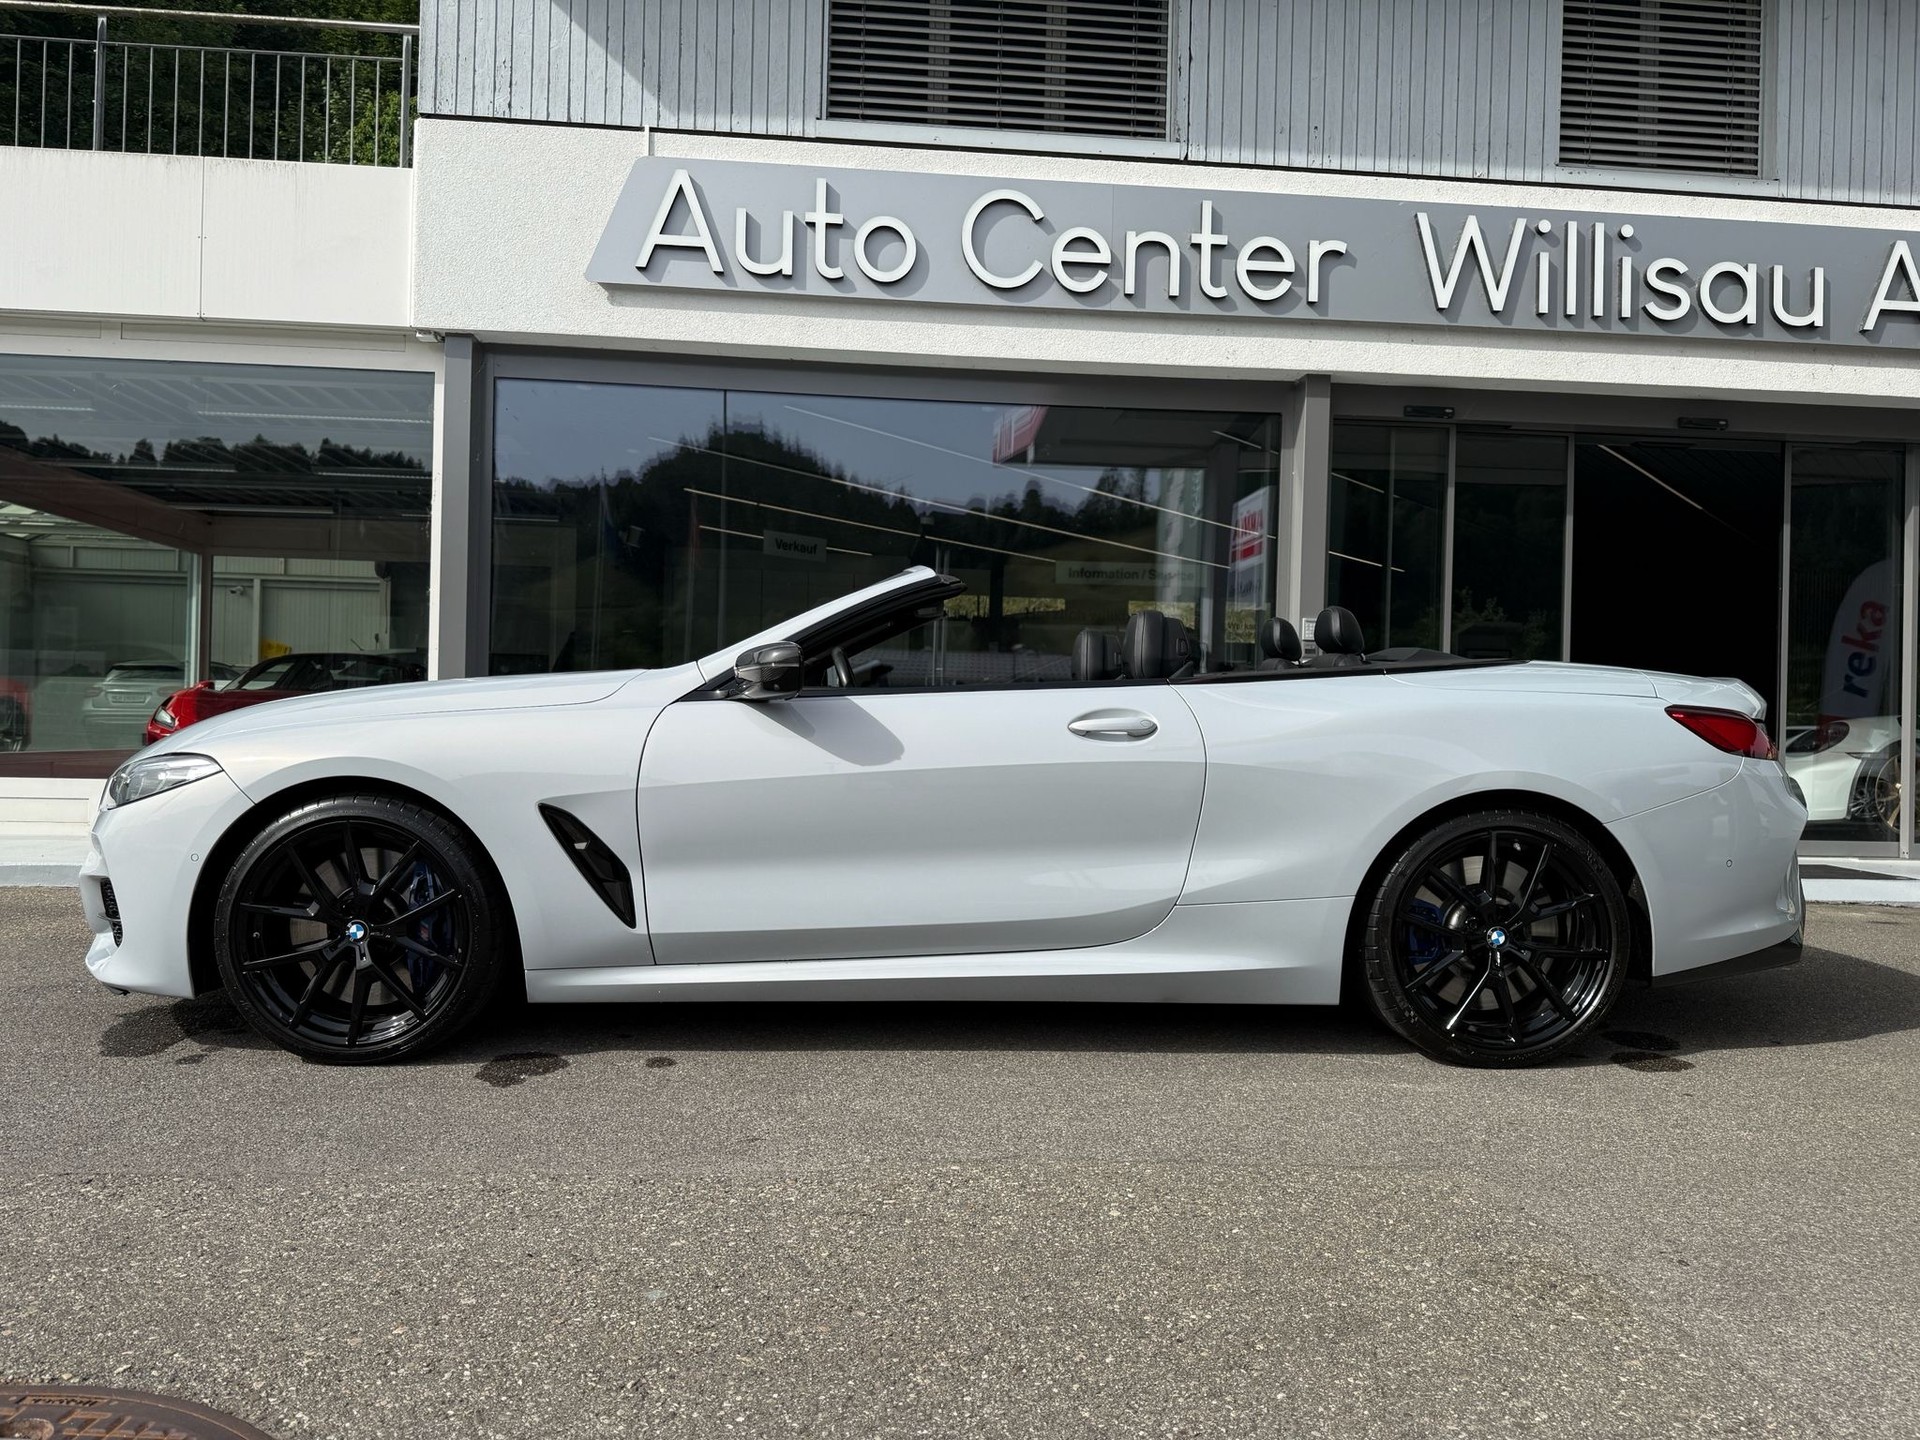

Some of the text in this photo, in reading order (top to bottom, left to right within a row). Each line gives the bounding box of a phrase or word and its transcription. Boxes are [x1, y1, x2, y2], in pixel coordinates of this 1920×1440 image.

[635, 168, 917, 284] Auto
[961, 188, 1348, 304] Center
[1415, 211, 1825, 328] Willisau
[774, 538, 818, 555] Verkauf
[1068, 566, 1139, 581] Information
[1148, 567, 1194, 581] Svce
[1841, 600, 1889, 698] reka
